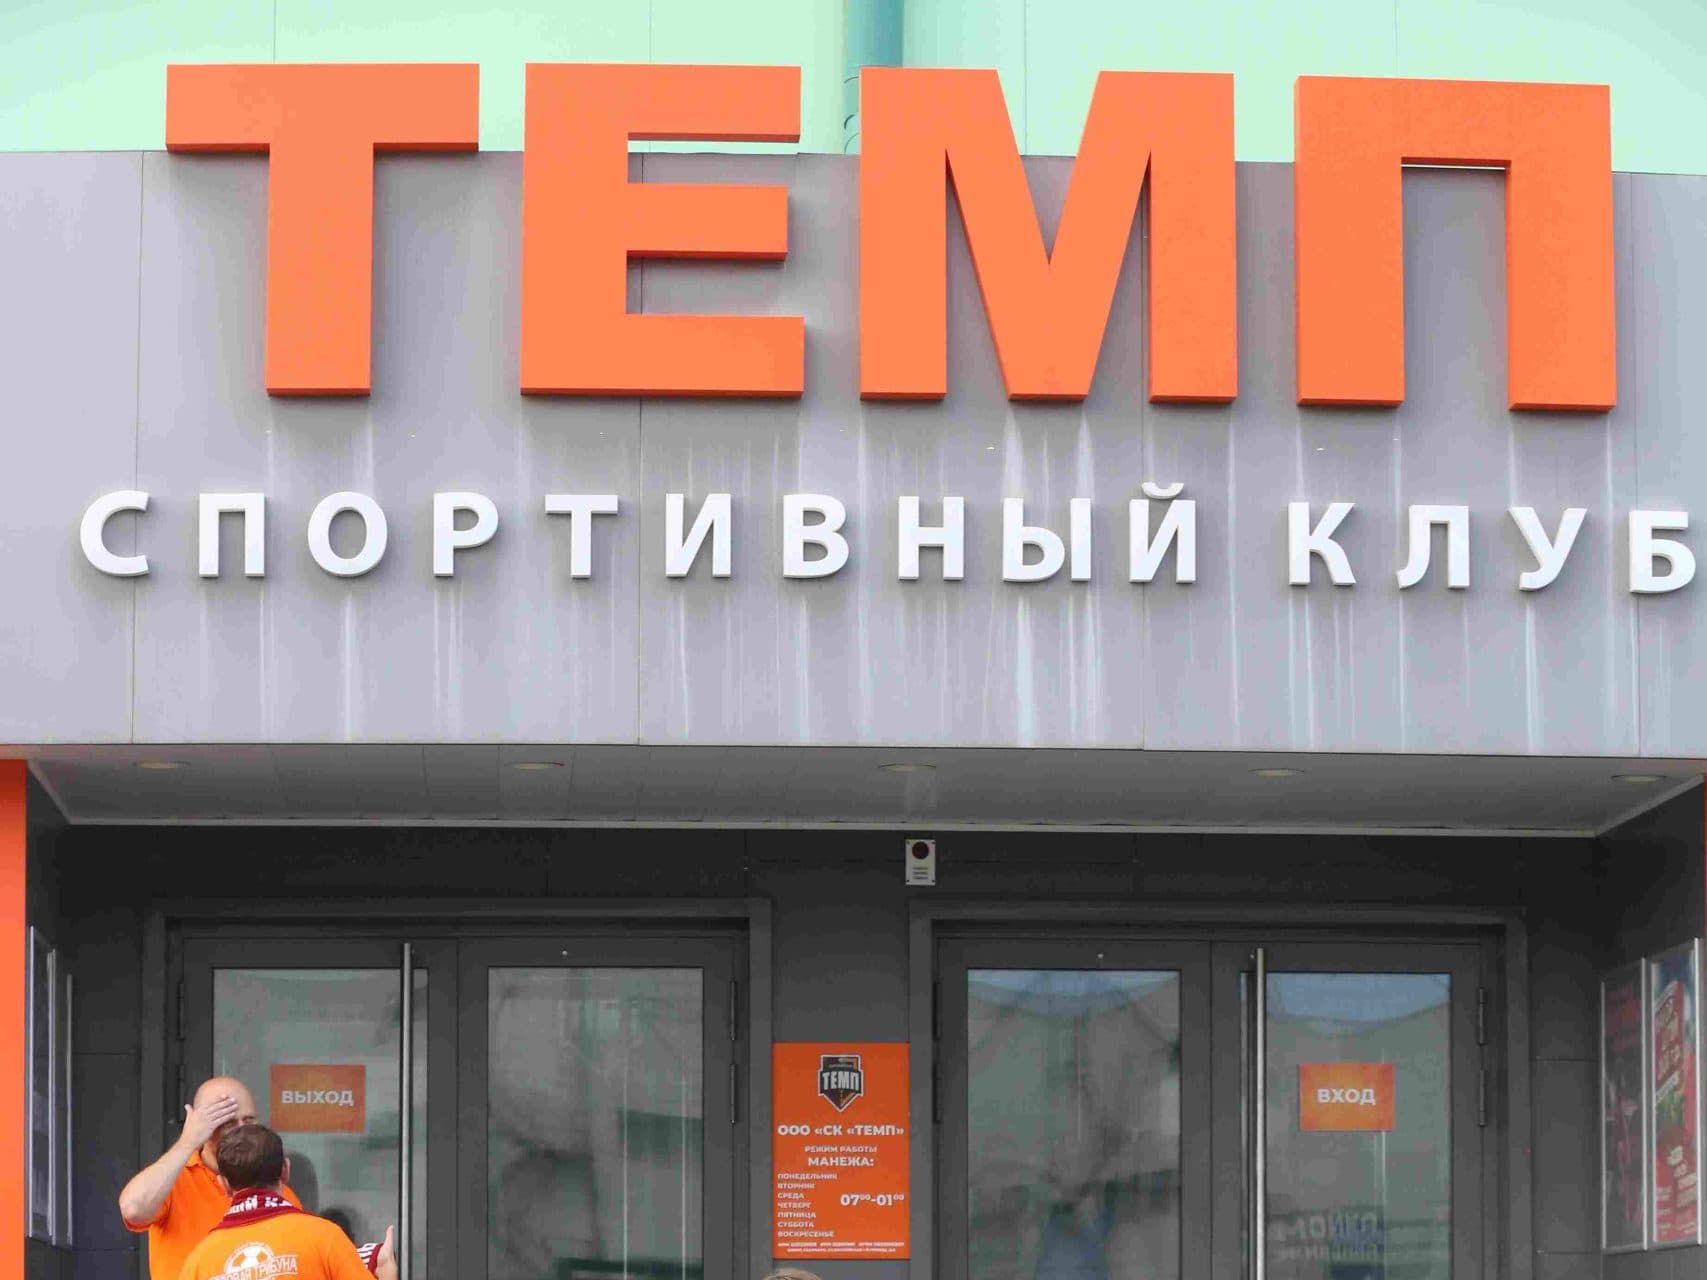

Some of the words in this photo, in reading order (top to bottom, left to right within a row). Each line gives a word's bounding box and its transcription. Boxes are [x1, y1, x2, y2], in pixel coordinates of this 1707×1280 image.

[166, 63, 1616, 413] ТЕМП
[79, 482, 1197, 585] СПОРТИВНЫЙ
[1288, 501, 1699, 595] КЛУБ
[822, 1070, 860, 1091] ТЕМП
[281, 1089, 355, 1108] ВЫХОД
[1317, 1088, 1377, 1106] ВХОД
[777, 1124, 811, 1136] ООО
[814, 1124, 843, 1136] «СК
[847, 1124, 904, 1136] «ТЕМП»
[804, 1145, 838, 1153] РЕЖИМ
[839, 1145, 878, 1153] РАБОТЫ
[808, 1156, 875, 1167] МАНЕЖА:
[777, 1211, 817, 1219] ПЯТНИЦА
[253, 1256, 299, 1280] ТРИБУНА
